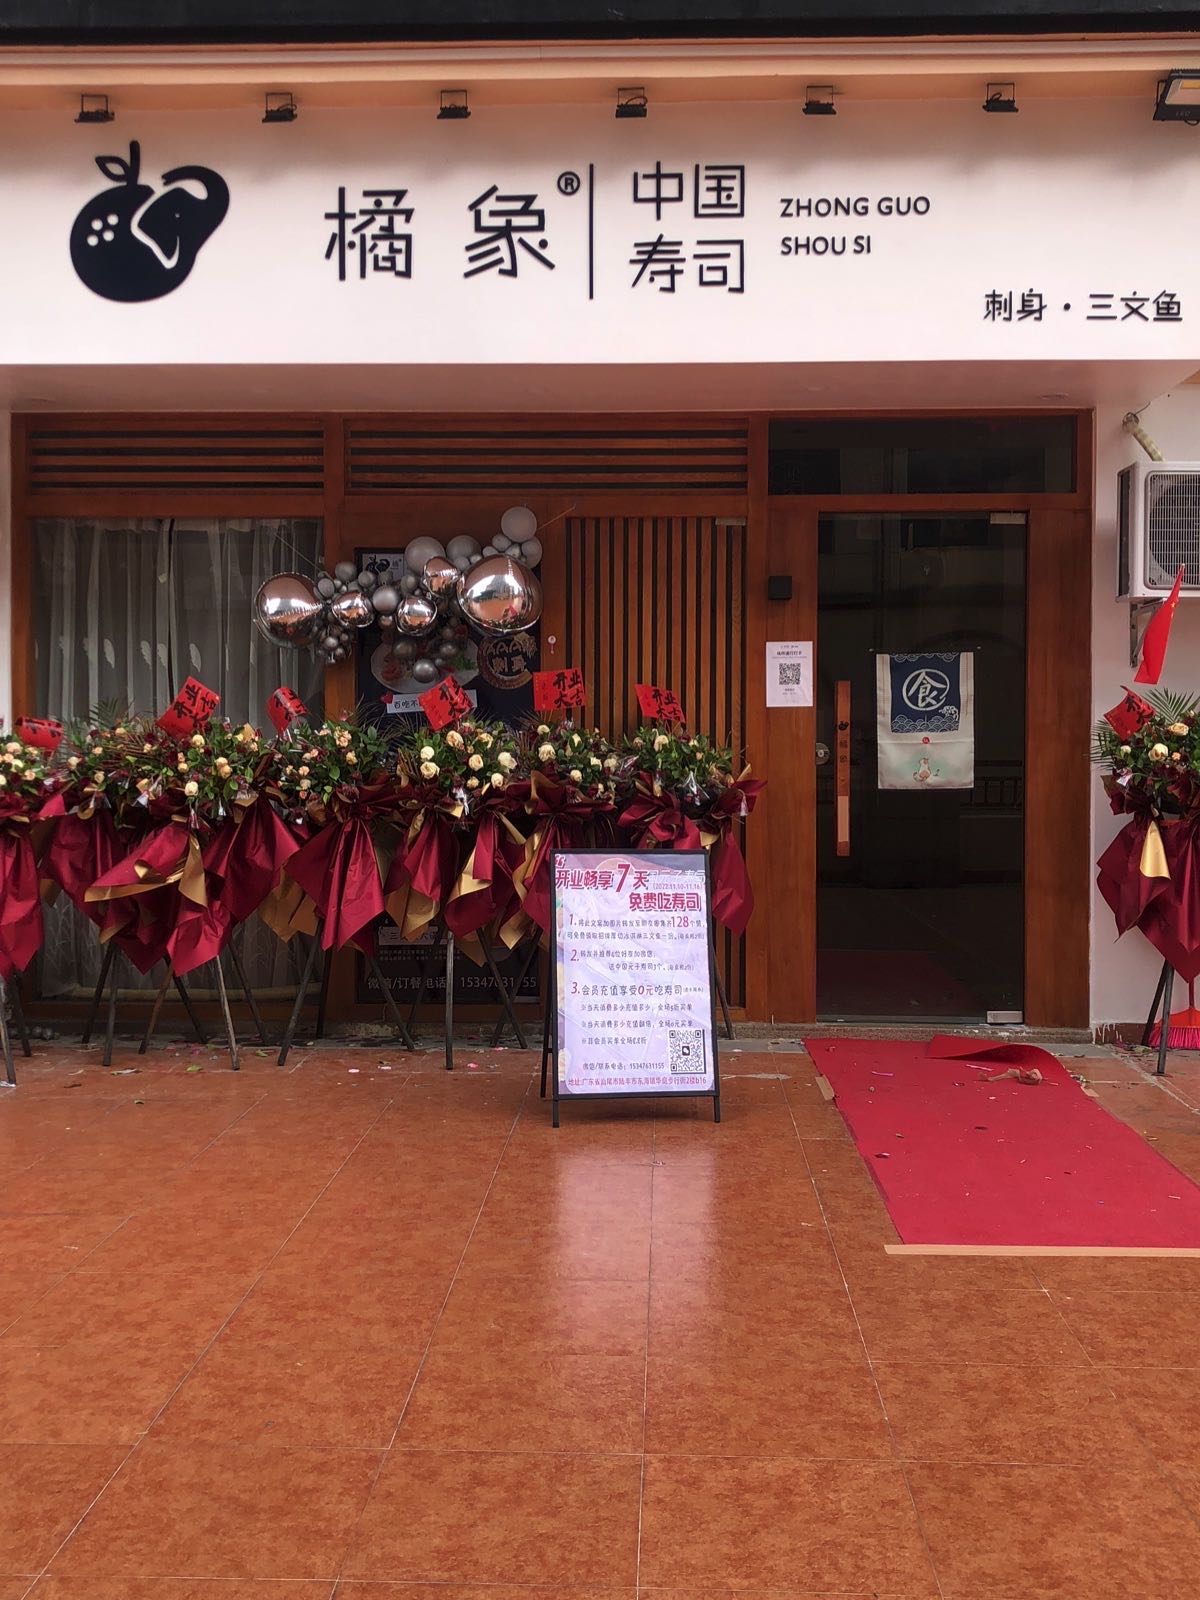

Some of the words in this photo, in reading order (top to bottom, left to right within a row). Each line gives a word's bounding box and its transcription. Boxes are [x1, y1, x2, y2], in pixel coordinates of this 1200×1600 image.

[633, 161, 746, 221] 中国
[780, 198, 869, 218] ZHONG
[877, 196, 931, 216] GUO
[325, 185, 555, 281] 橘象
[780, 236, 847, 256] SHOU
[853, 235, 872, 255] SI
[629, 233, 746, 294] 寿司
[907, 669, 945, 707] 食
[555, 864, 650, 892] 开业畅享7天
[629, 892, 702, 912] 免费吃寿司
